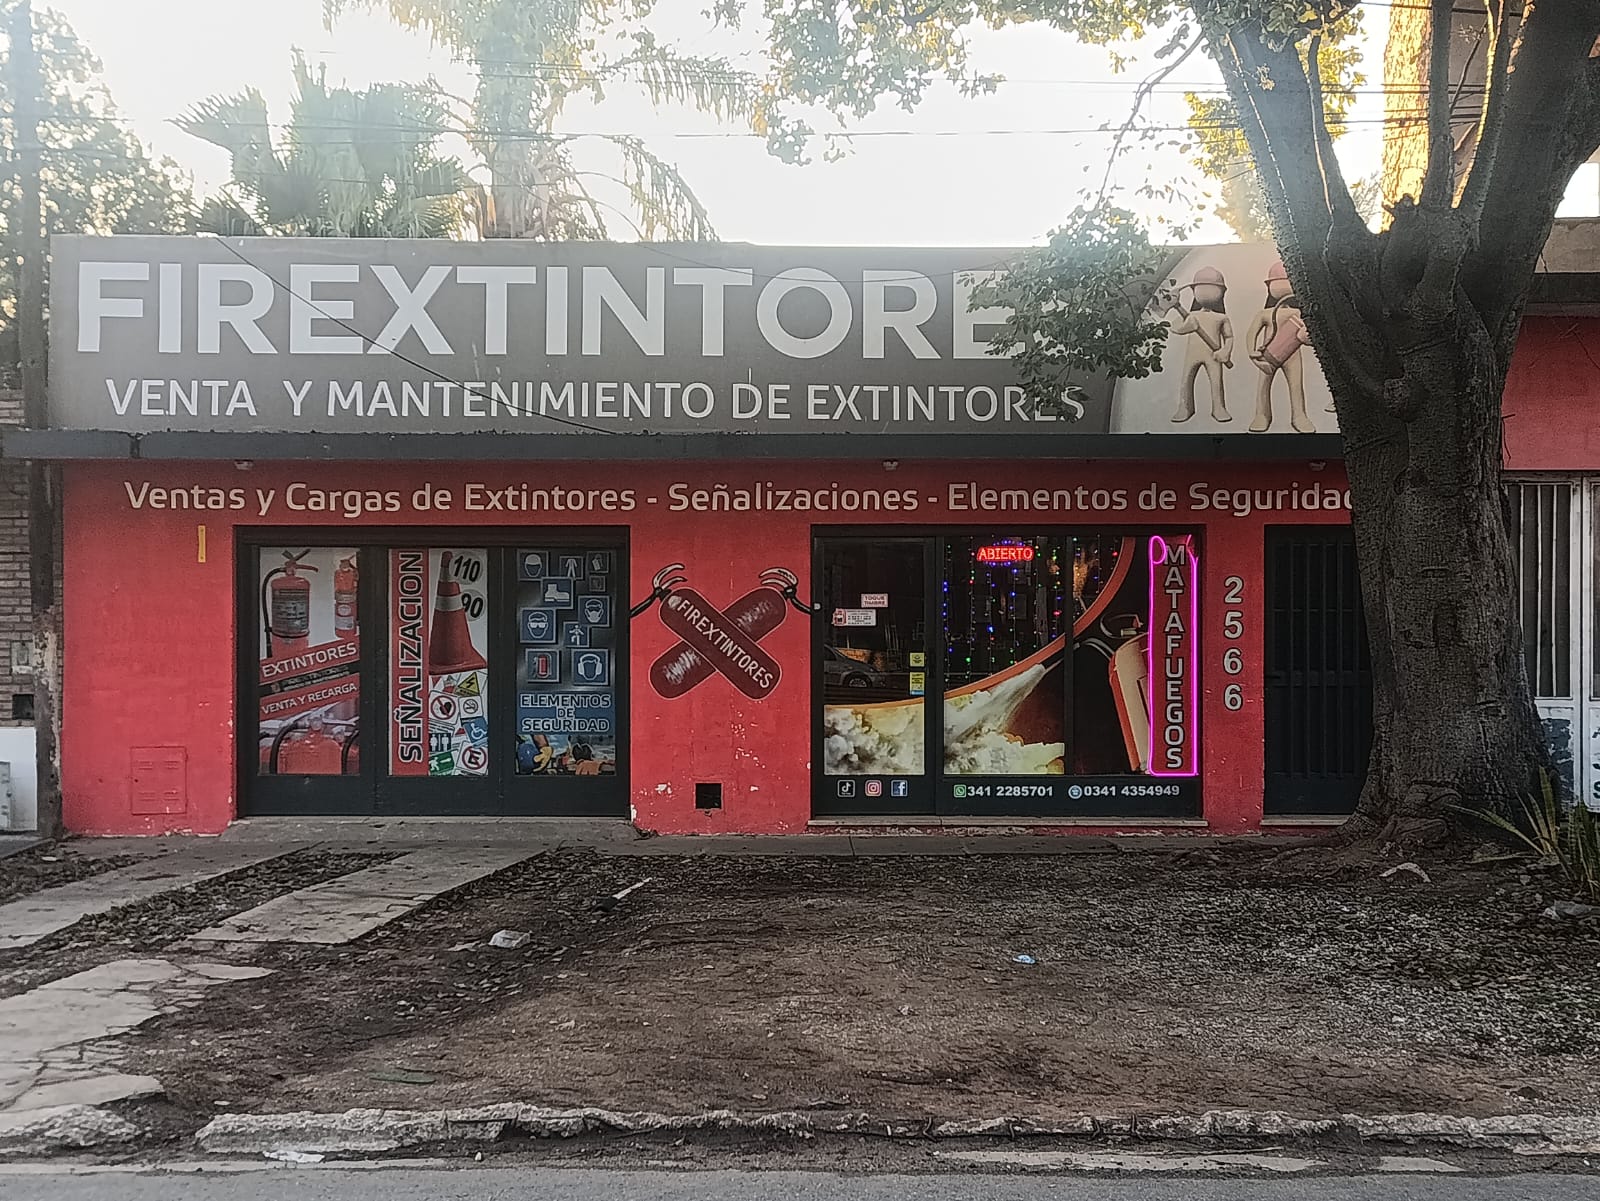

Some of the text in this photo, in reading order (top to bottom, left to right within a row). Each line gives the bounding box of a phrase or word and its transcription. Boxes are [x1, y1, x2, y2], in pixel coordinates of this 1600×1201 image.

[105, 379, 257, 416] VENTA
[282, 381, 312, 416] Y
[327, 380, 715, 418] MANTENIMIENTO
[732, 382, 791, 419] DE
[124, 482, 245, 510] Ventas
[256, 489, 275, 516] y
[286, 483, 401, 518] Cargas
[412, 483, 451, 511] de
[465, 483, 636, 511] Extintores
[668, 482, 919, 512] Señalizaciones
[949, 483, 1127, 511] Elementos
[1138, 483, 1177, 511] de
[453, 555, 481, 582] 110
[979, 547, 1033, 561] ABIERTO
[461, 592, 484, 619] 90
[394, 551, 423, 763] SEÑALIZACION
[676, 599, 774, 689] FIREXTINTORES
[1164, 545, 1185, 769] MATAFUEGOS
[1222, 575, 1244, 712] 2566
[262, 642, 357, 678] EXTINTORES
[262, 682, 358, 714] VENTA Y RECARGA
[520, 693, 611, 709] ELEMENTOS
[521, 718, 610, 732] SEGURIDAD
[556, 707, 576, 719] DE
[967, 785, 1053, 797] 341 2285701
[1083, 785, 1180, 797] 0341 4354949
